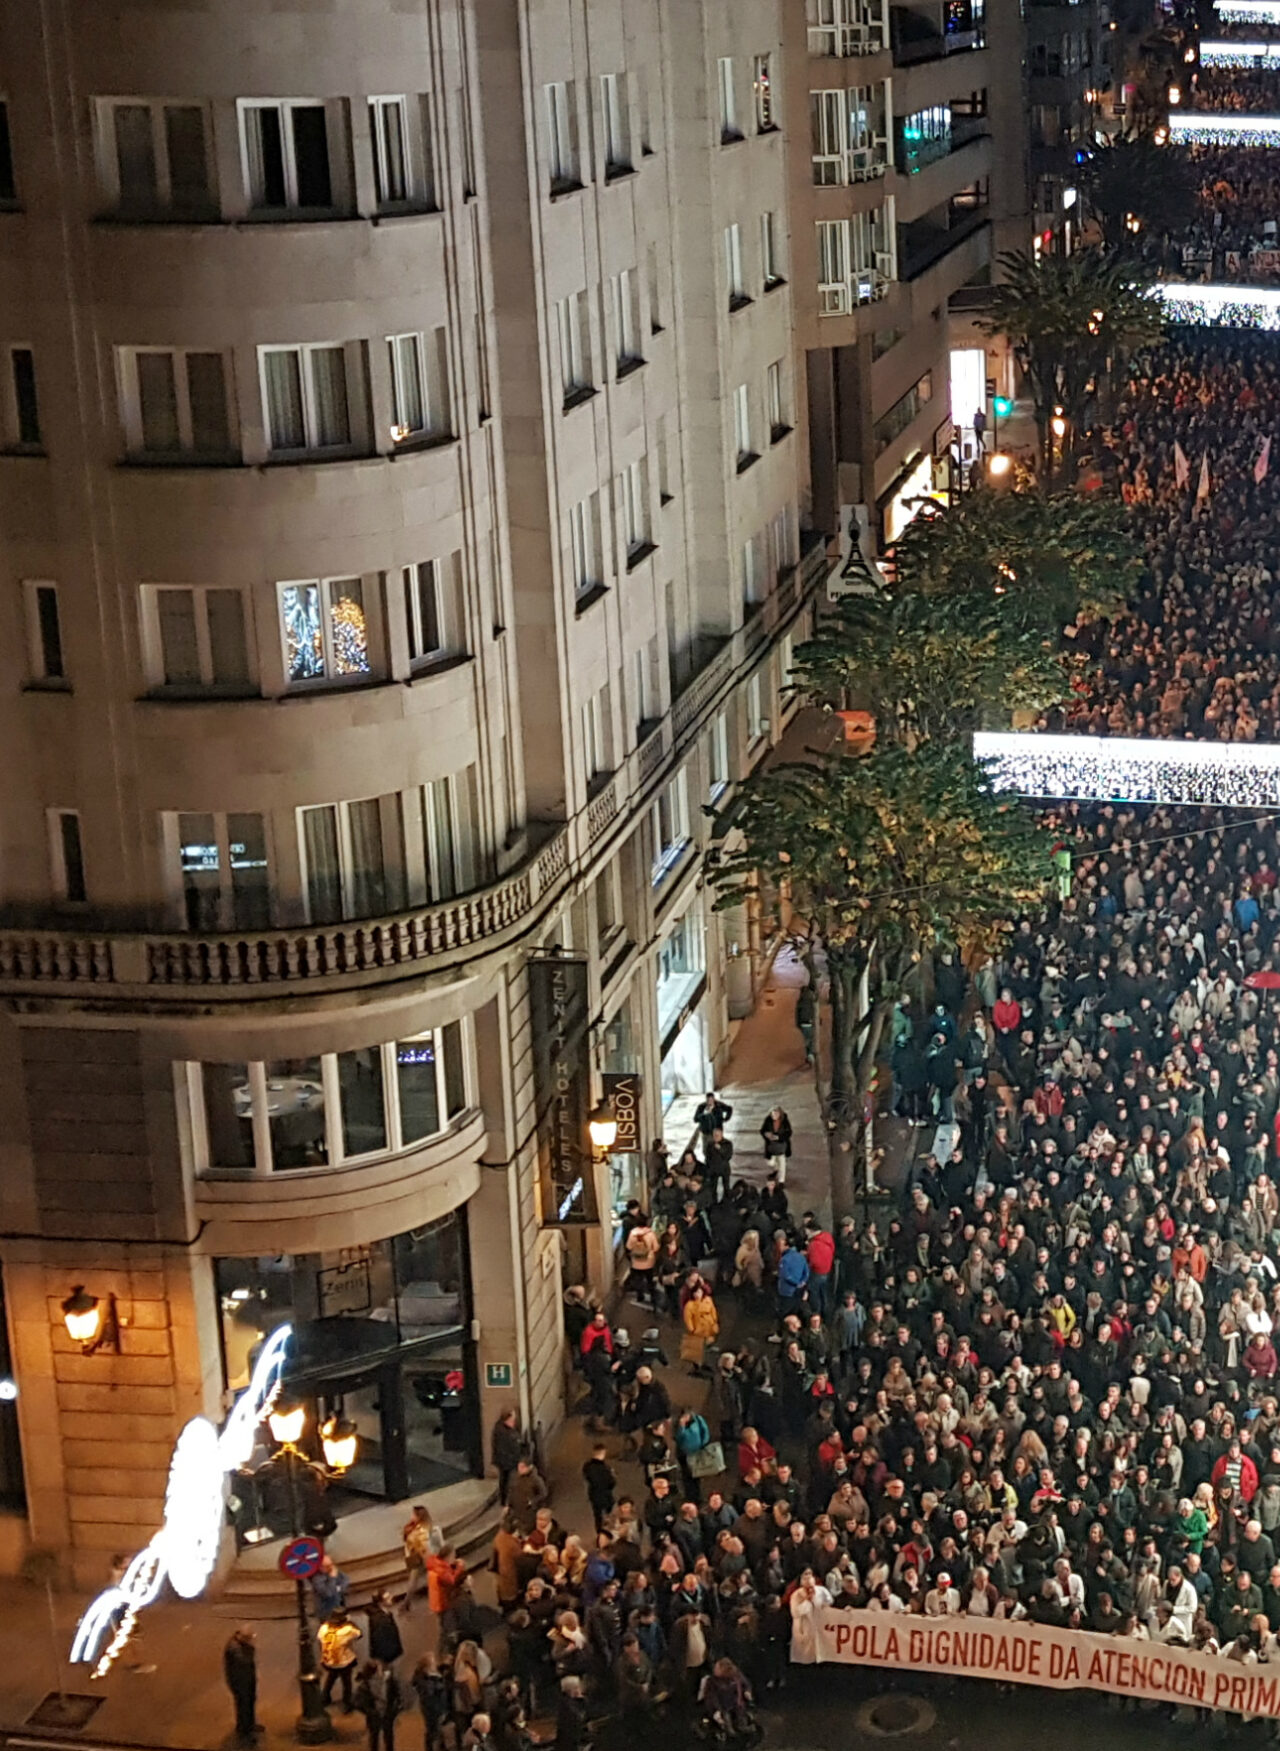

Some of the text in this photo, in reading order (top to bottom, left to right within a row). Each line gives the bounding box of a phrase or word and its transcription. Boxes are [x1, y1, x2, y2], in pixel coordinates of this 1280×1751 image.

[552, 970, 572, 1172] ZENIT HOTELES
[909, 1630, 1043, 1676] DIGNIDADE
[1050, 1643, 1080, 1680] DA
[1088, 1649, 1206, 1700] ATENCION
